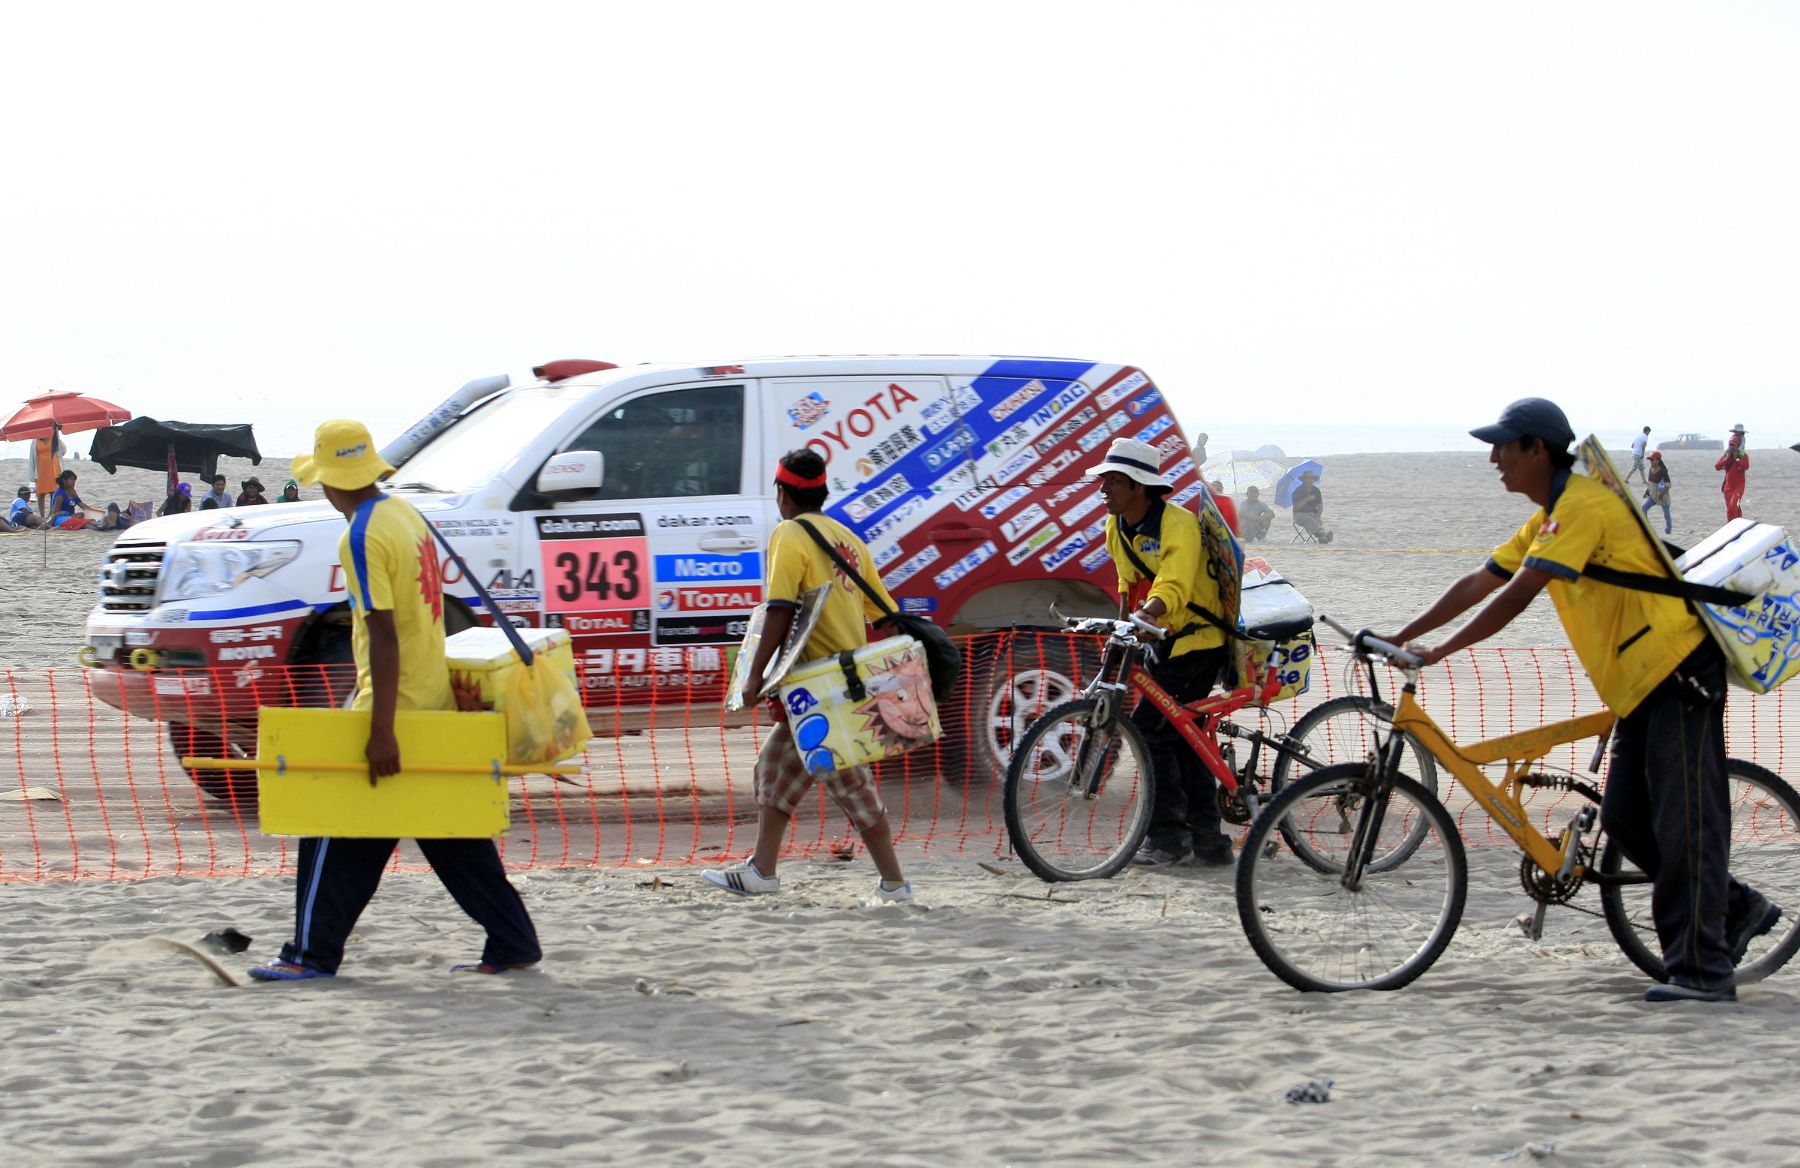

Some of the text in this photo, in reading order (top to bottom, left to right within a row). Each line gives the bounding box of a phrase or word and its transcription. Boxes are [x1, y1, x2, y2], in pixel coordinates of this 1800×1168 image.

[803, 383, 919, 465] OYOTA
[541, 517, 641, 534] dakar.com
[657, 515, 753, 527] dakar.com
[556, 550, 640, 602] 343
[675, 559, 743, 577] Macro
[681, 591, 760, 608] TOTAL
[565, 616, 630, 631] TOTAL
[1132, 670, 1181, 718] Bianchi
